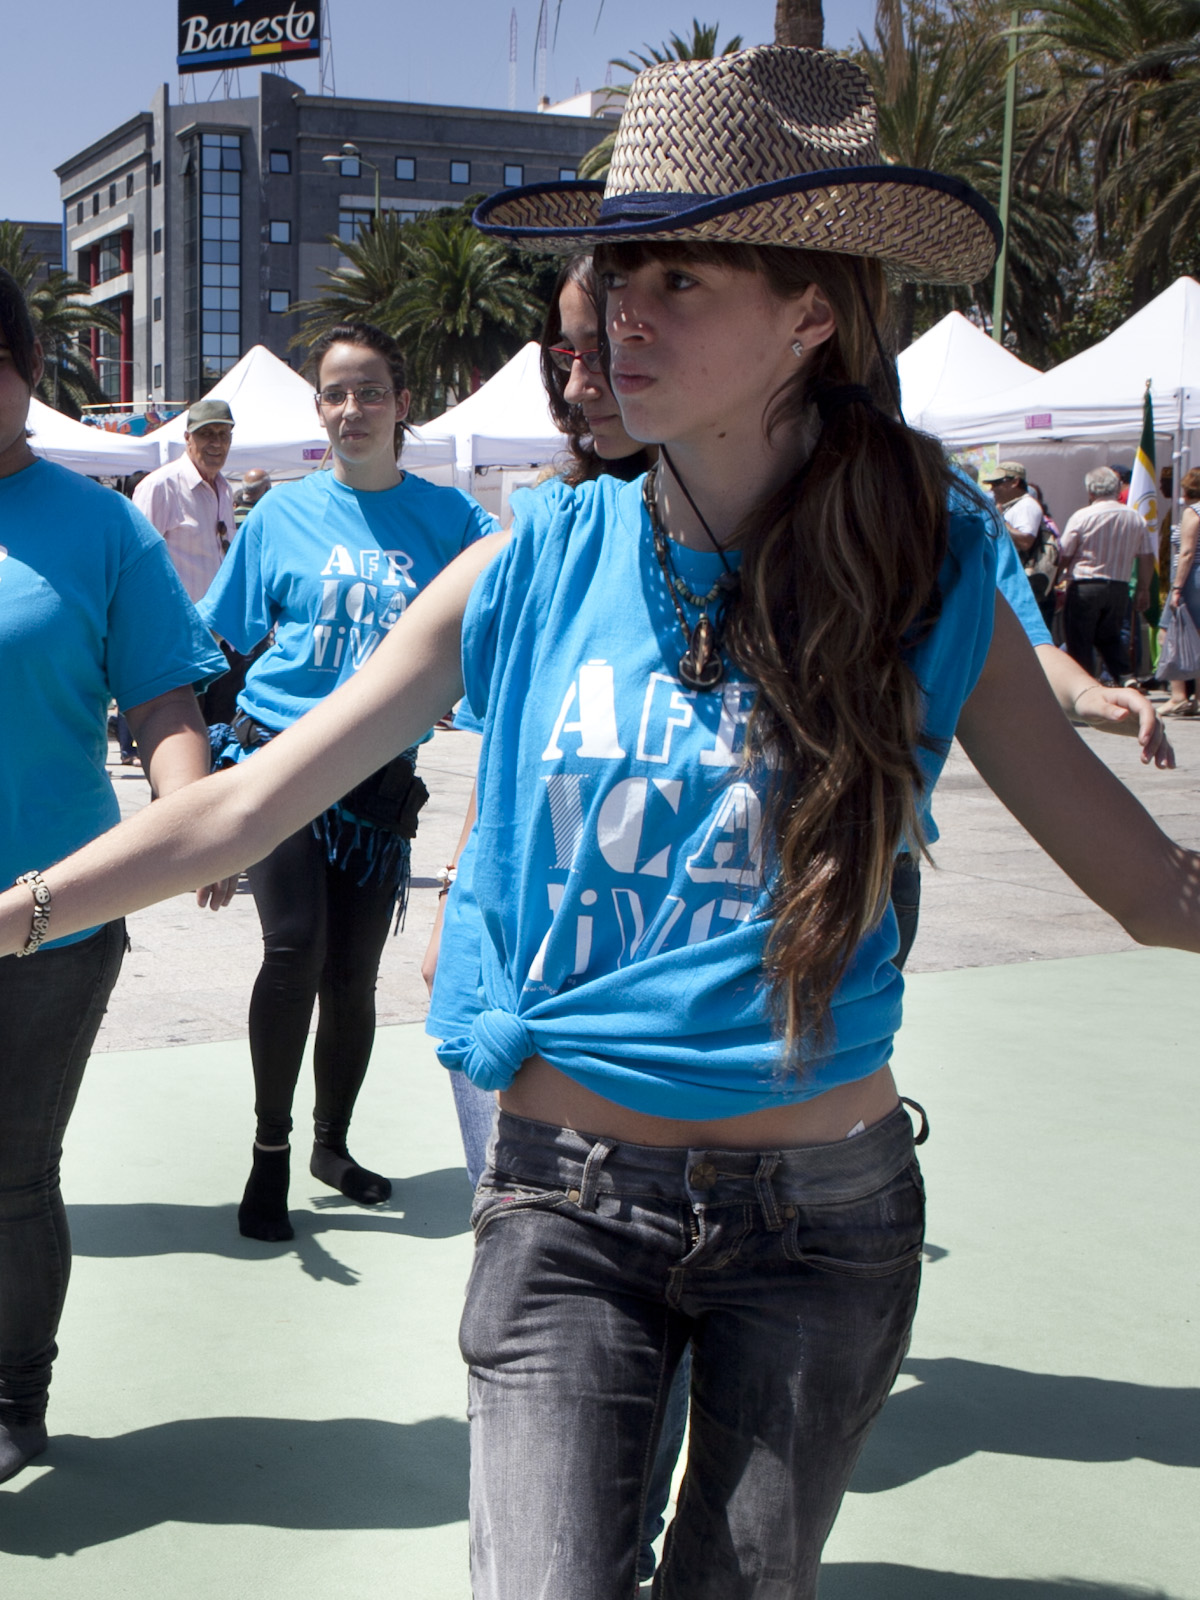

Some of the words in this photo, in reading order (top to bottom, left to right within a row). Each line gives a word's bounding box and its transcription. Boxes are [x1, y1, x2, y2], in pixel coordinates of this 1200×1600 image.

[181, 1, 315, 54] Banesto
[320, 544, 417, 588] AFR
[318, 579, 406, 630] ICA
[540, 773, 762, 887] ICA
